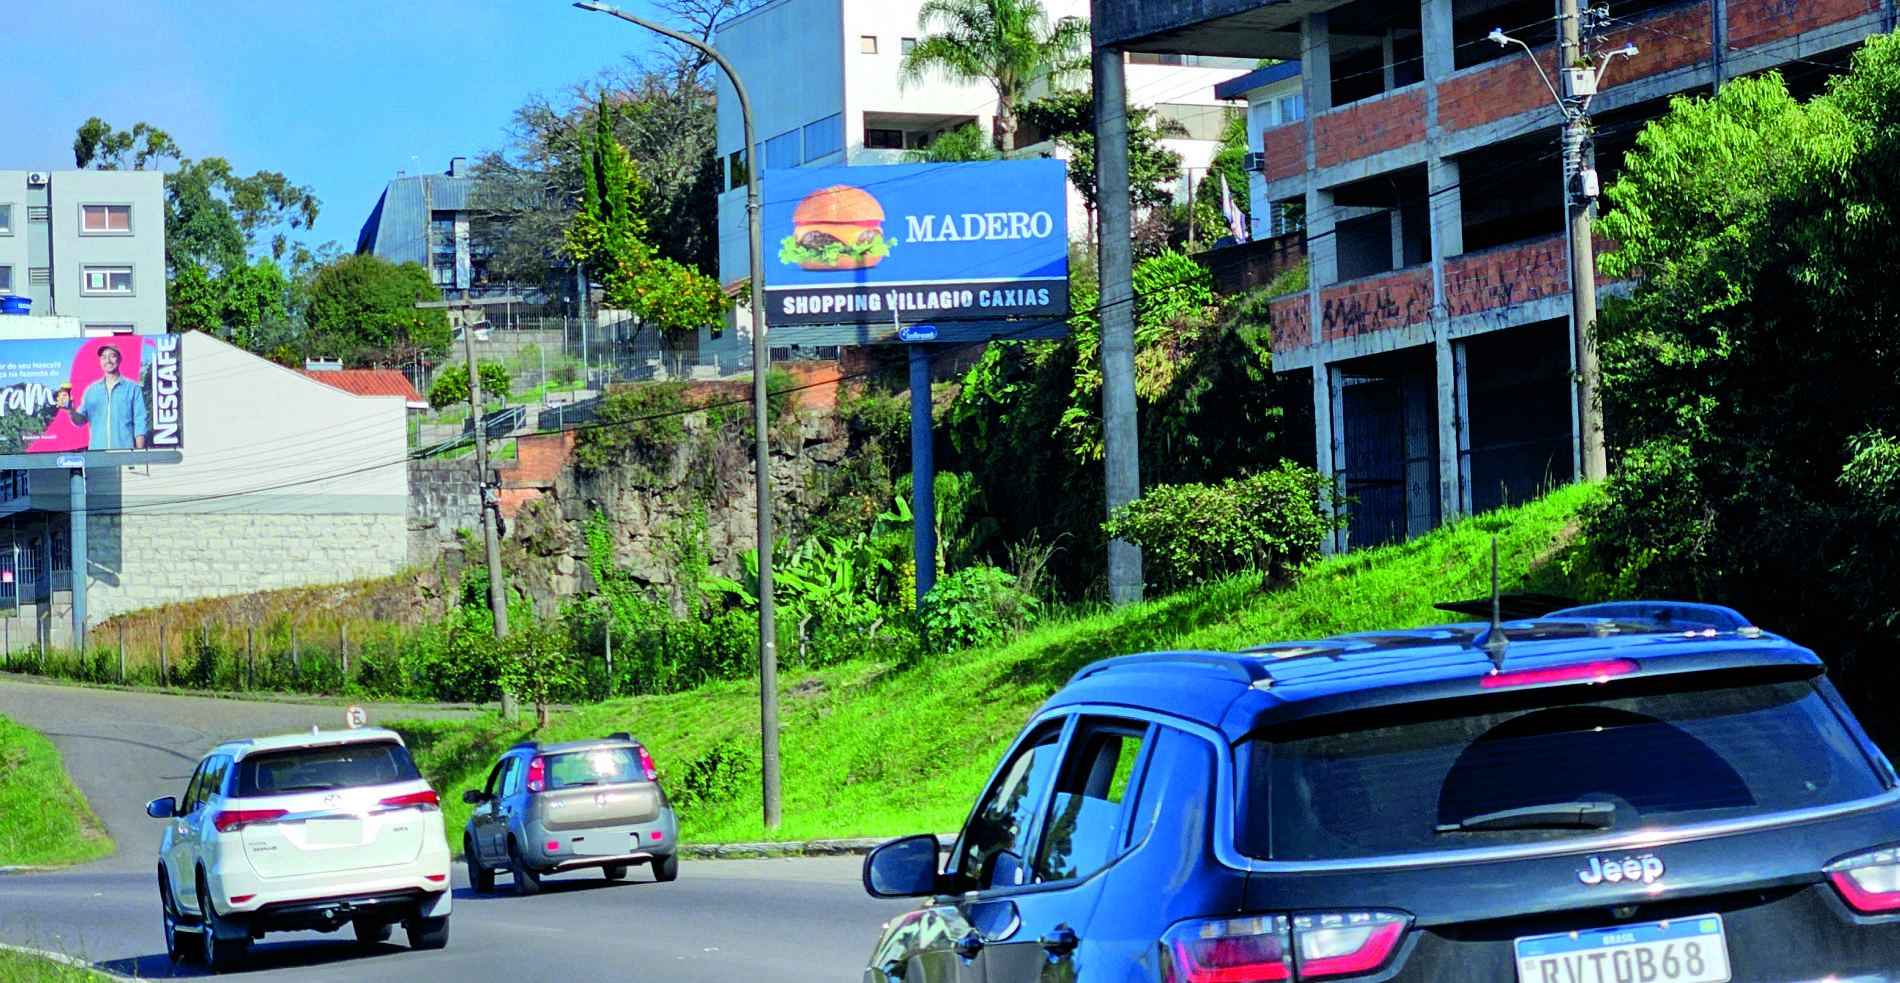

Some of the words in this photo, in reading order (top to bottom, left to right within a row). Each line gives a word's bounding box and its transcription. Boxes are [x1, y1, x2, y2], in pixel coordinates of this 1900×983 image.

[905, 211, 1053, 243] MADERO
[783, 292, 882, 315] SHOPPING
[886, 289, 973, 312] VILLAGIO
[979, 288, 1050, 308] CAXIAS
[1578, 856, 1665, 884] Jeep
[1602, 932, 1636, 946] BRASIL
